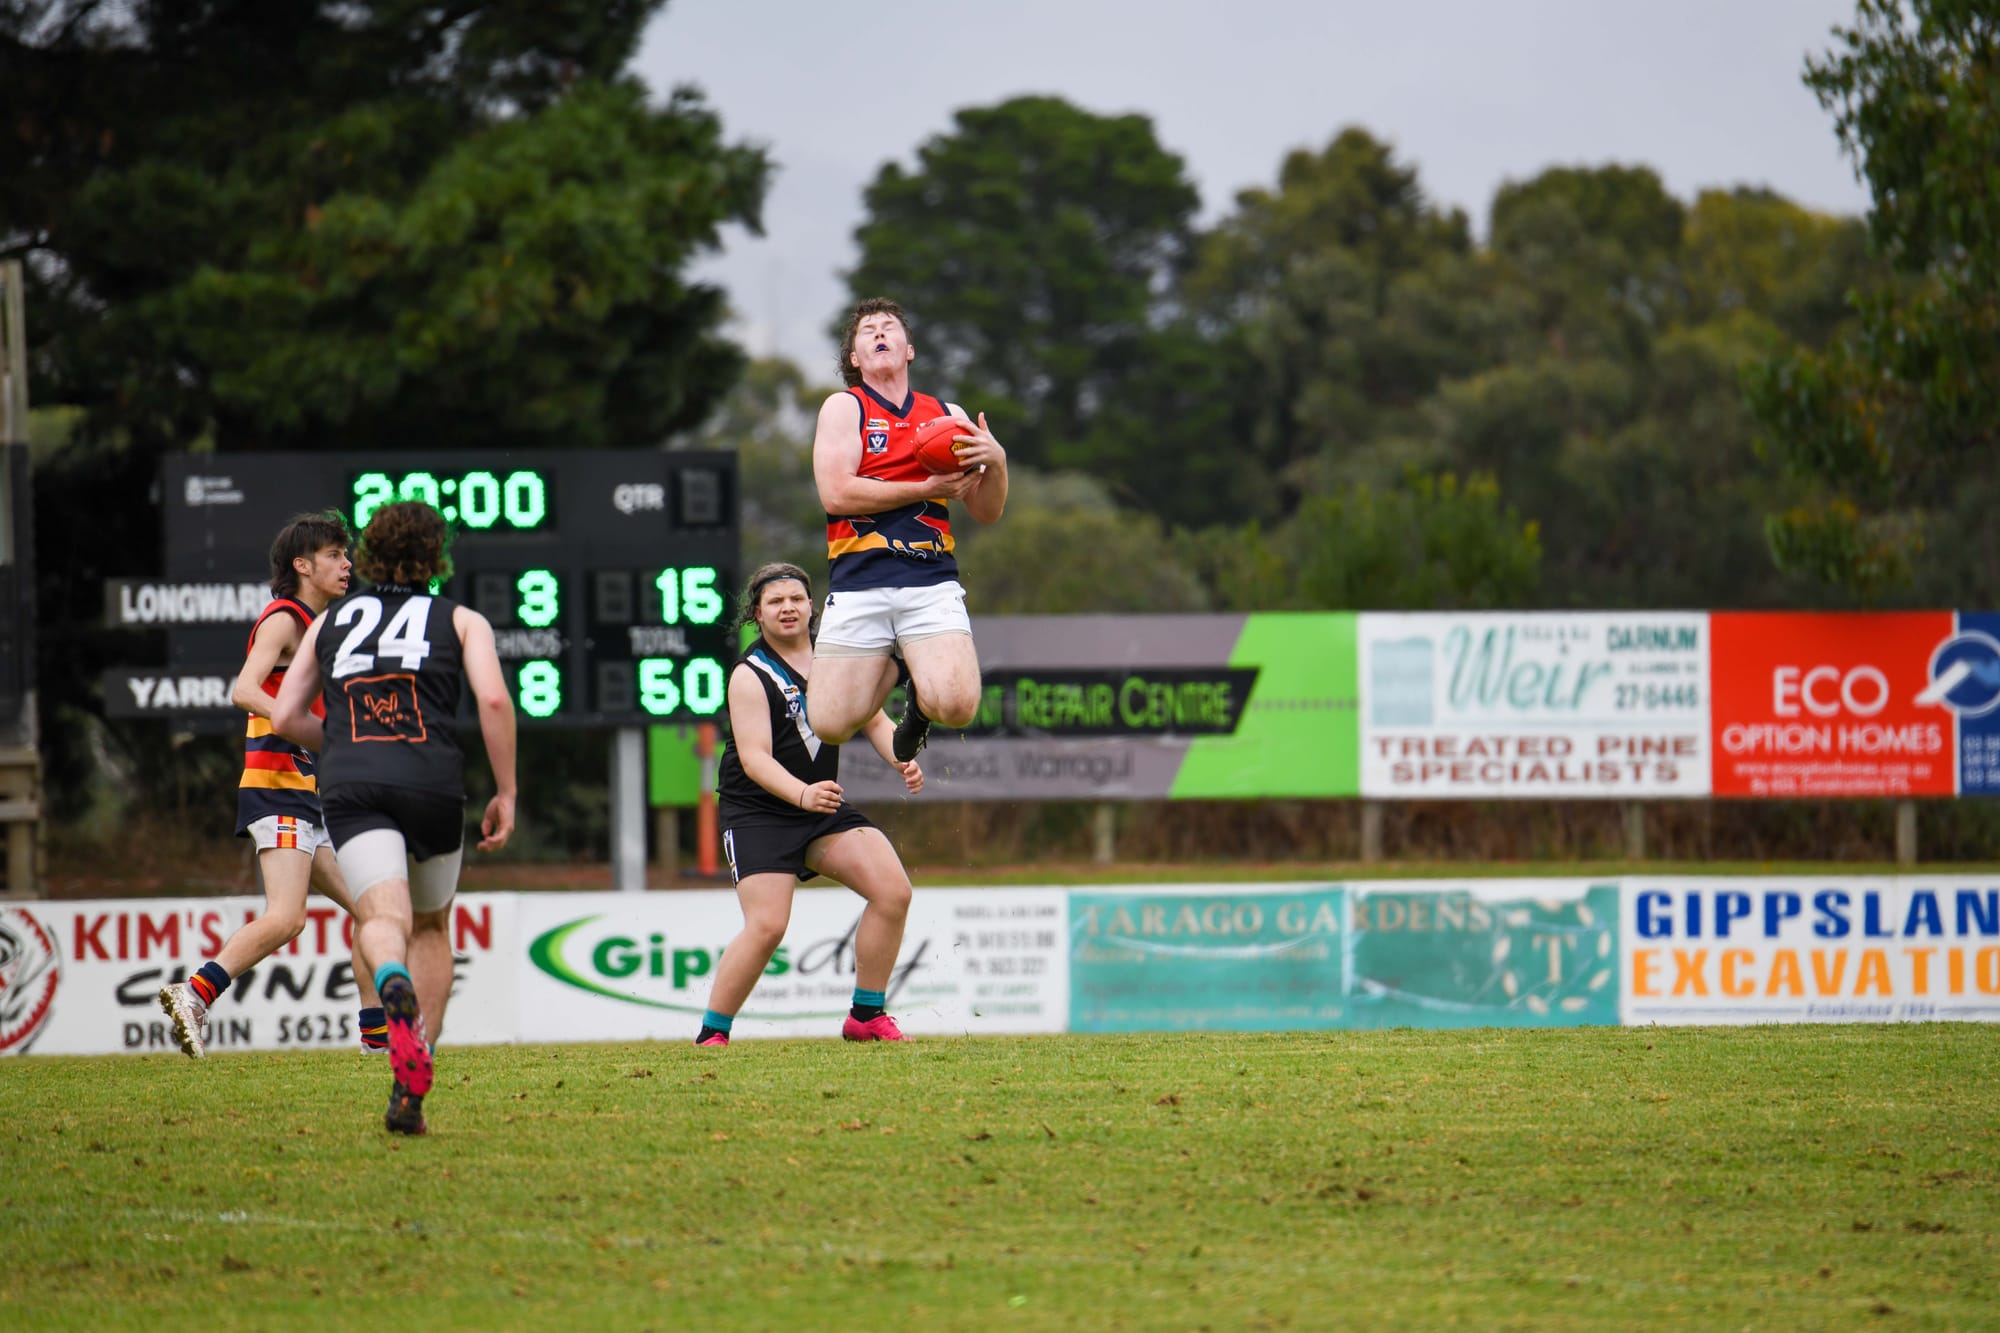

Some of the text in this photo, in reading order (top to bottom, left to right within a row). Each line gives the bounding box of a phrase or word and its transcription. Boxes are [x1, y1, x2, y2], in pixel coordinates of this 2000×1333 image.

[613, 483, 665, 514] QTR
[517, 569, 559, 627] 3
[655, 567, 723, 625] 15
[331, 595, 433, 679] 24
[628, 627, 691, 657] TOTAL
[1606, 626, 1697, 650] DARNUM
[519, 660, 561, 718] 8
[638, 657, 725, 716] 50
[1444, 624, 1614, 711] Weir
[1773, 665, 1890, 718] ECO
[1016, 678, 1116, 728] REPAIR
[1119, 676, 1233, 729] CENTRE
[1373, 735, 1698, 758] TREATED PINE
[1721, 723, 1832, 755] OPTION
[1838, 723, 1942, 755] HOMES
[1016, 751, 1135, 787] Warragul
[1390, 761, 1680, 784] SPECIALISTS
[73, 911, 223, 961] KIM'S
[1080, 901, 1264, 937] TARAGO
[1635, 889, 2000, 939] GIPPSLAN
[278, 1014, 351, 1043] 5625
